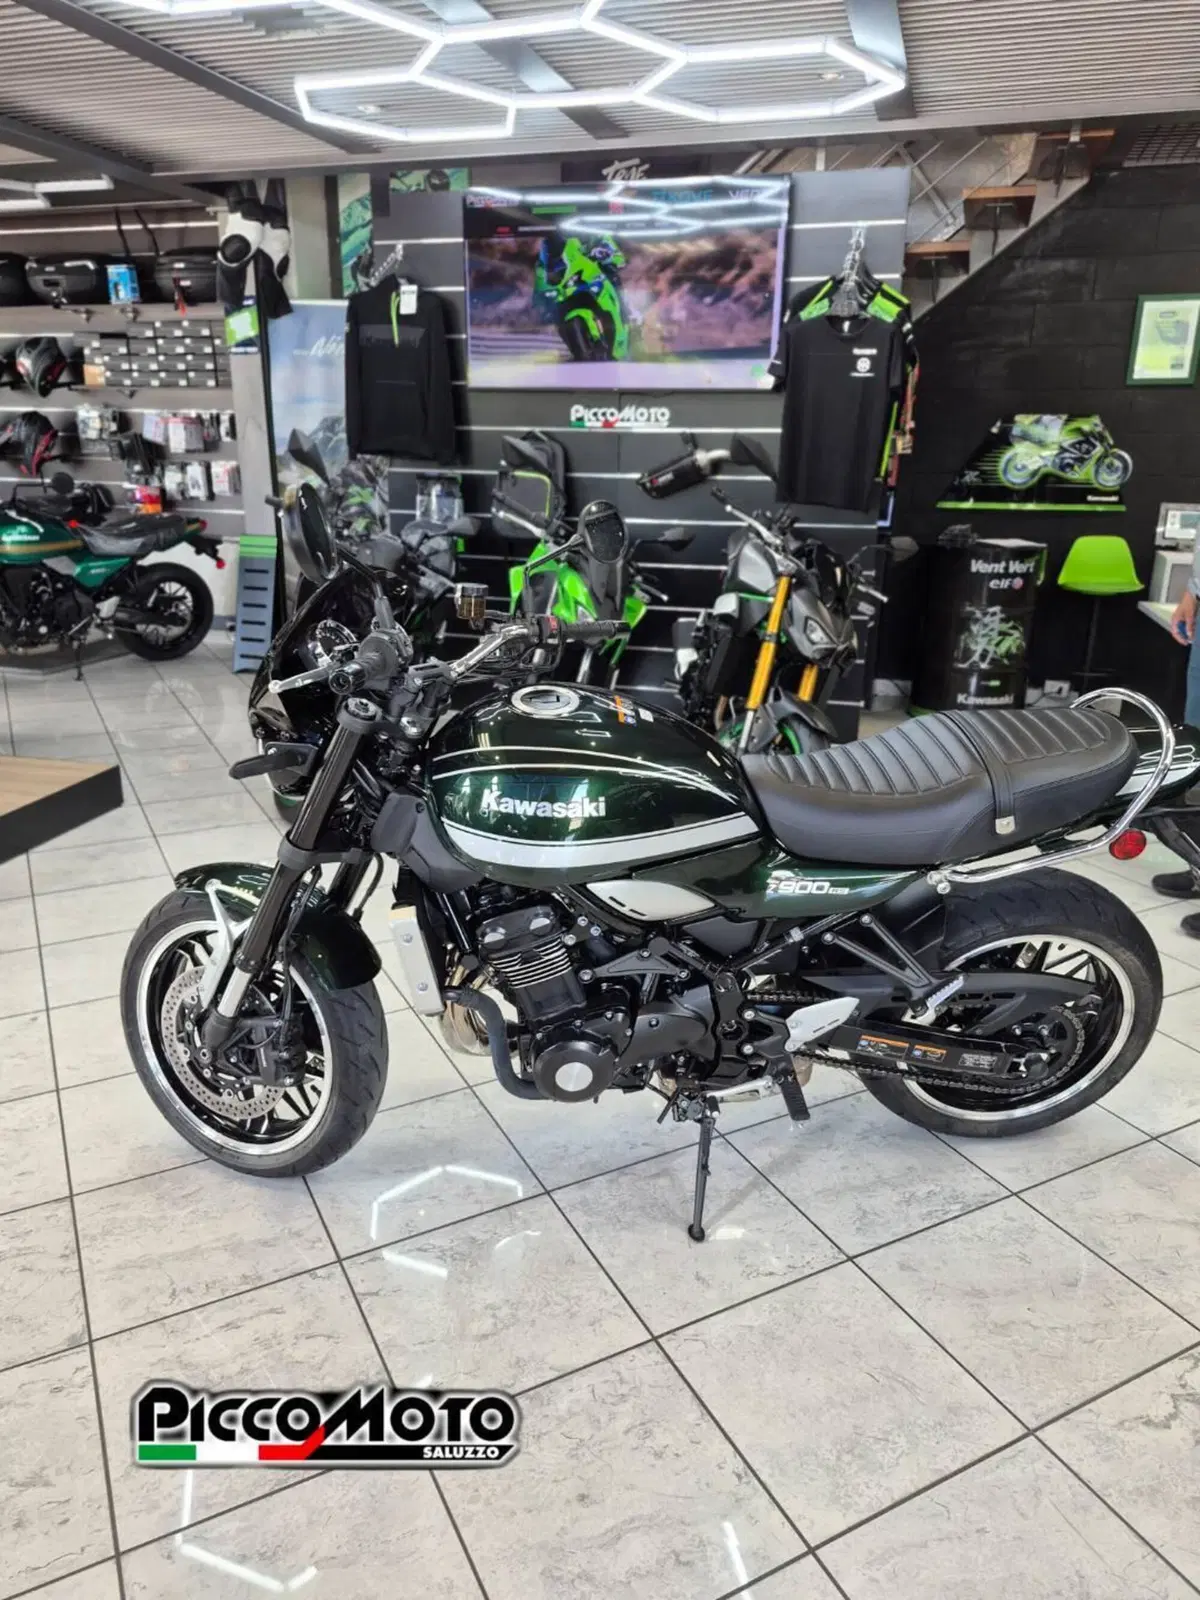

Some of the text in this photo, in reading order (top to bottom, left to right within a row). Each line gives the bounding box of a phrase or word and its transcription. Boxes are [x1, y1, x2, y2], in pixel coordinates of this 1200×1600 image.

[970, 559, 1006, 573] Vent
[989, 579, 1012, 589] elf
[480, 788, 606, 818] Kawasaki
